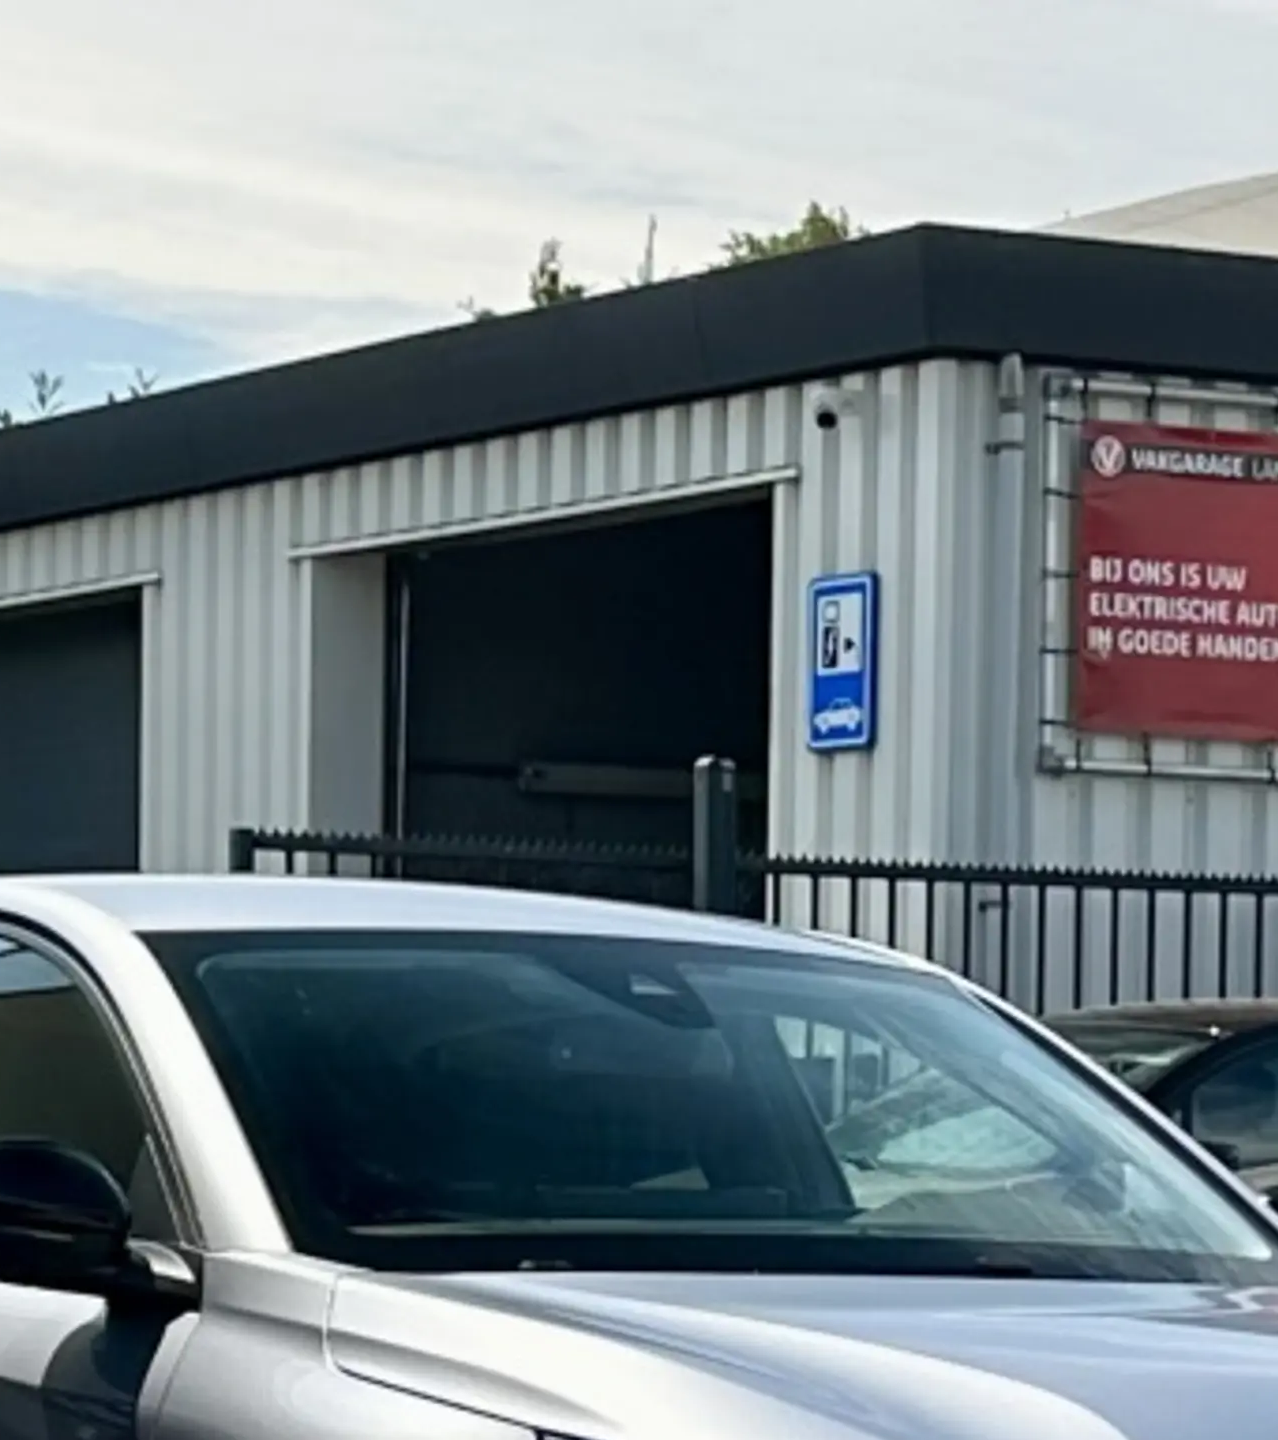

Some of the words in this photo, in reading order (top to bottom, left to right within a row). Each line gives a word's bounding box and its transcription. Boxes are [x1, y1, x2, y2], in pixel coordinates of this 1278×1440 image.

[1131, 448, 1244, 479] VAKGARAGE
[1089, 556, 1122, 584] BIJ
[1128, 559, 1174, 587] ONS
[1180, 562, 1201, 589] IS
[1206, 565, 1247, 592] UW
[1089, 592, 1231, 625] ELEKTRISCHE
[1087, 626, 1113, 652] IN
[1118, 629, 1192, 658] GOEDE
